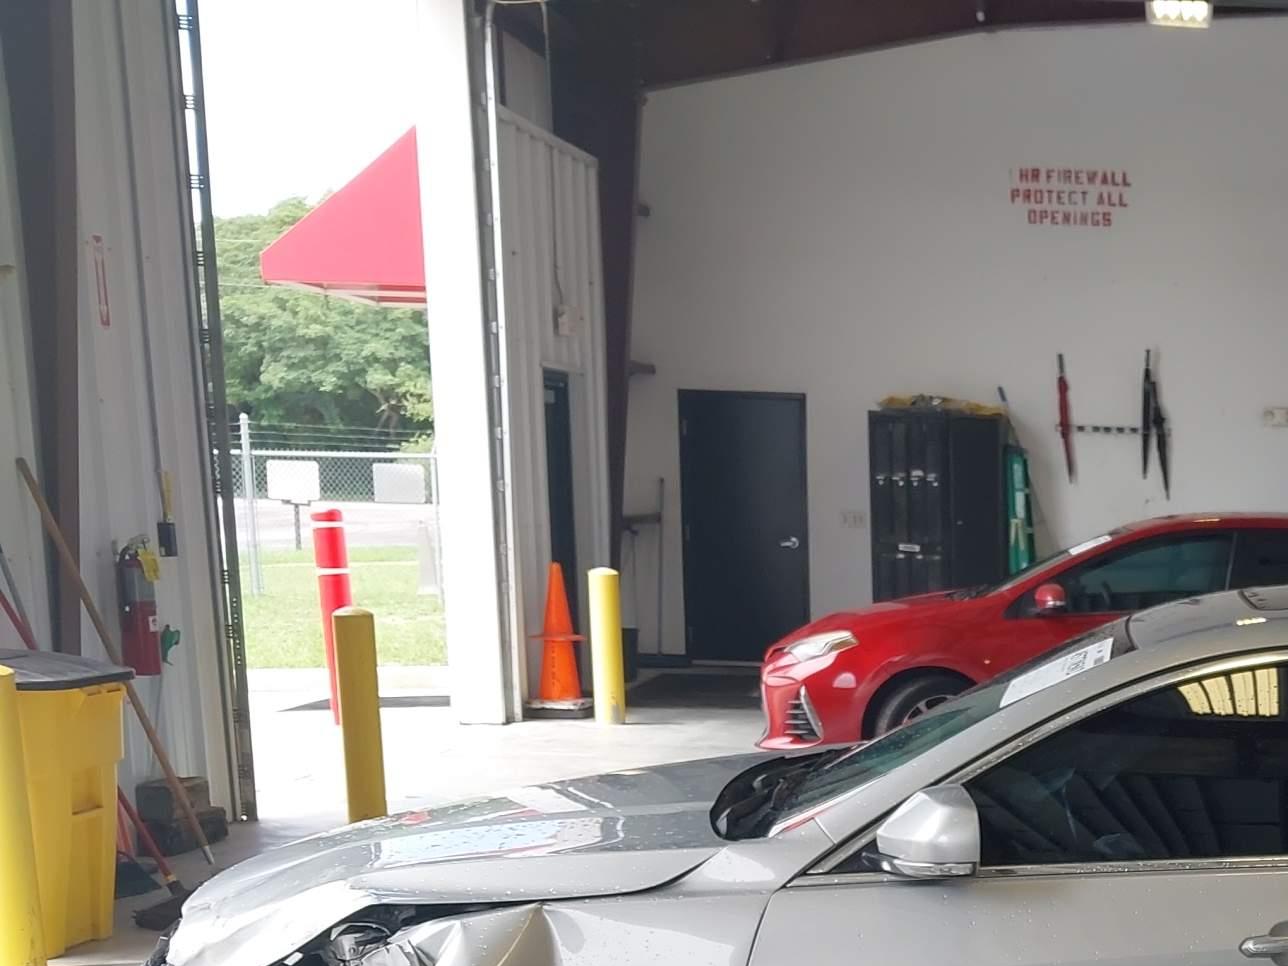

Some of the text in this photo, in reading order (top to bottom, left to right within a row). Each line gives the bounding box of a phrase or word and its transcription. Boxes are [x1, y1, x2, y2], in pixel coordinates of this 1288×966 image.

[1046, 168, 1132, 187] FIREWALL
[1010, 188, 1128, 207] PROTECT ALL
[1027, 209, 1112, 226] OPENINGS
